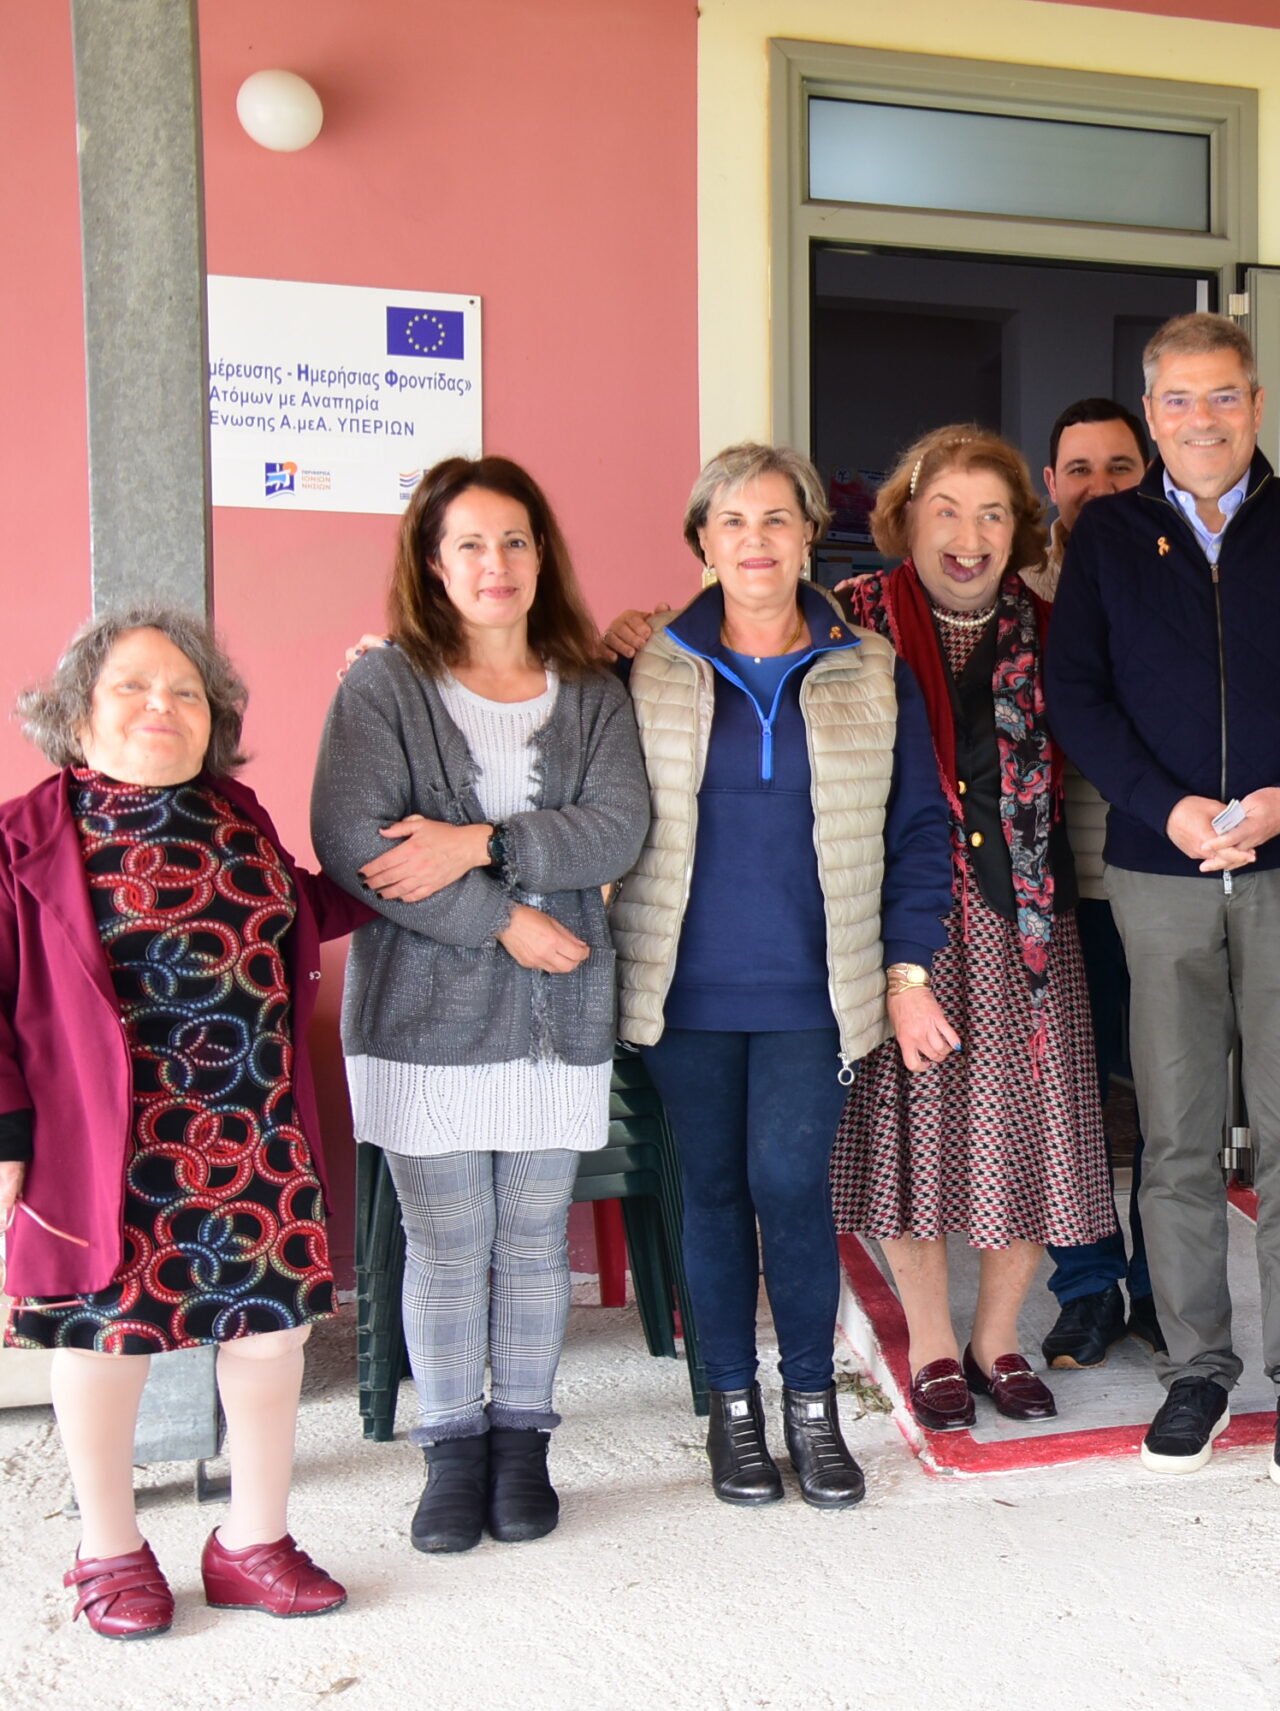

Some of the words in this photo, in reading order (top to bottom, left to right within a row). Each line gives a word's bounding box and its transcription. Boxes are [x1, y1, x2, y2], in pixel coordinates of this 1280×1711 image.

[297, 363, 380, 391] Ημερήσιας
[384, 369, 472, 396] Φροντίδας»
[209, 385, 273, 407] Ατόμων
[279, 393, 296, 409] με
[301, 391, 379, 414] Αναπηρία
[280, 414, 332, 433] Α.μεΑ.
[338, 417, 414, 436] ΥΠΕΡΙΩΝ
